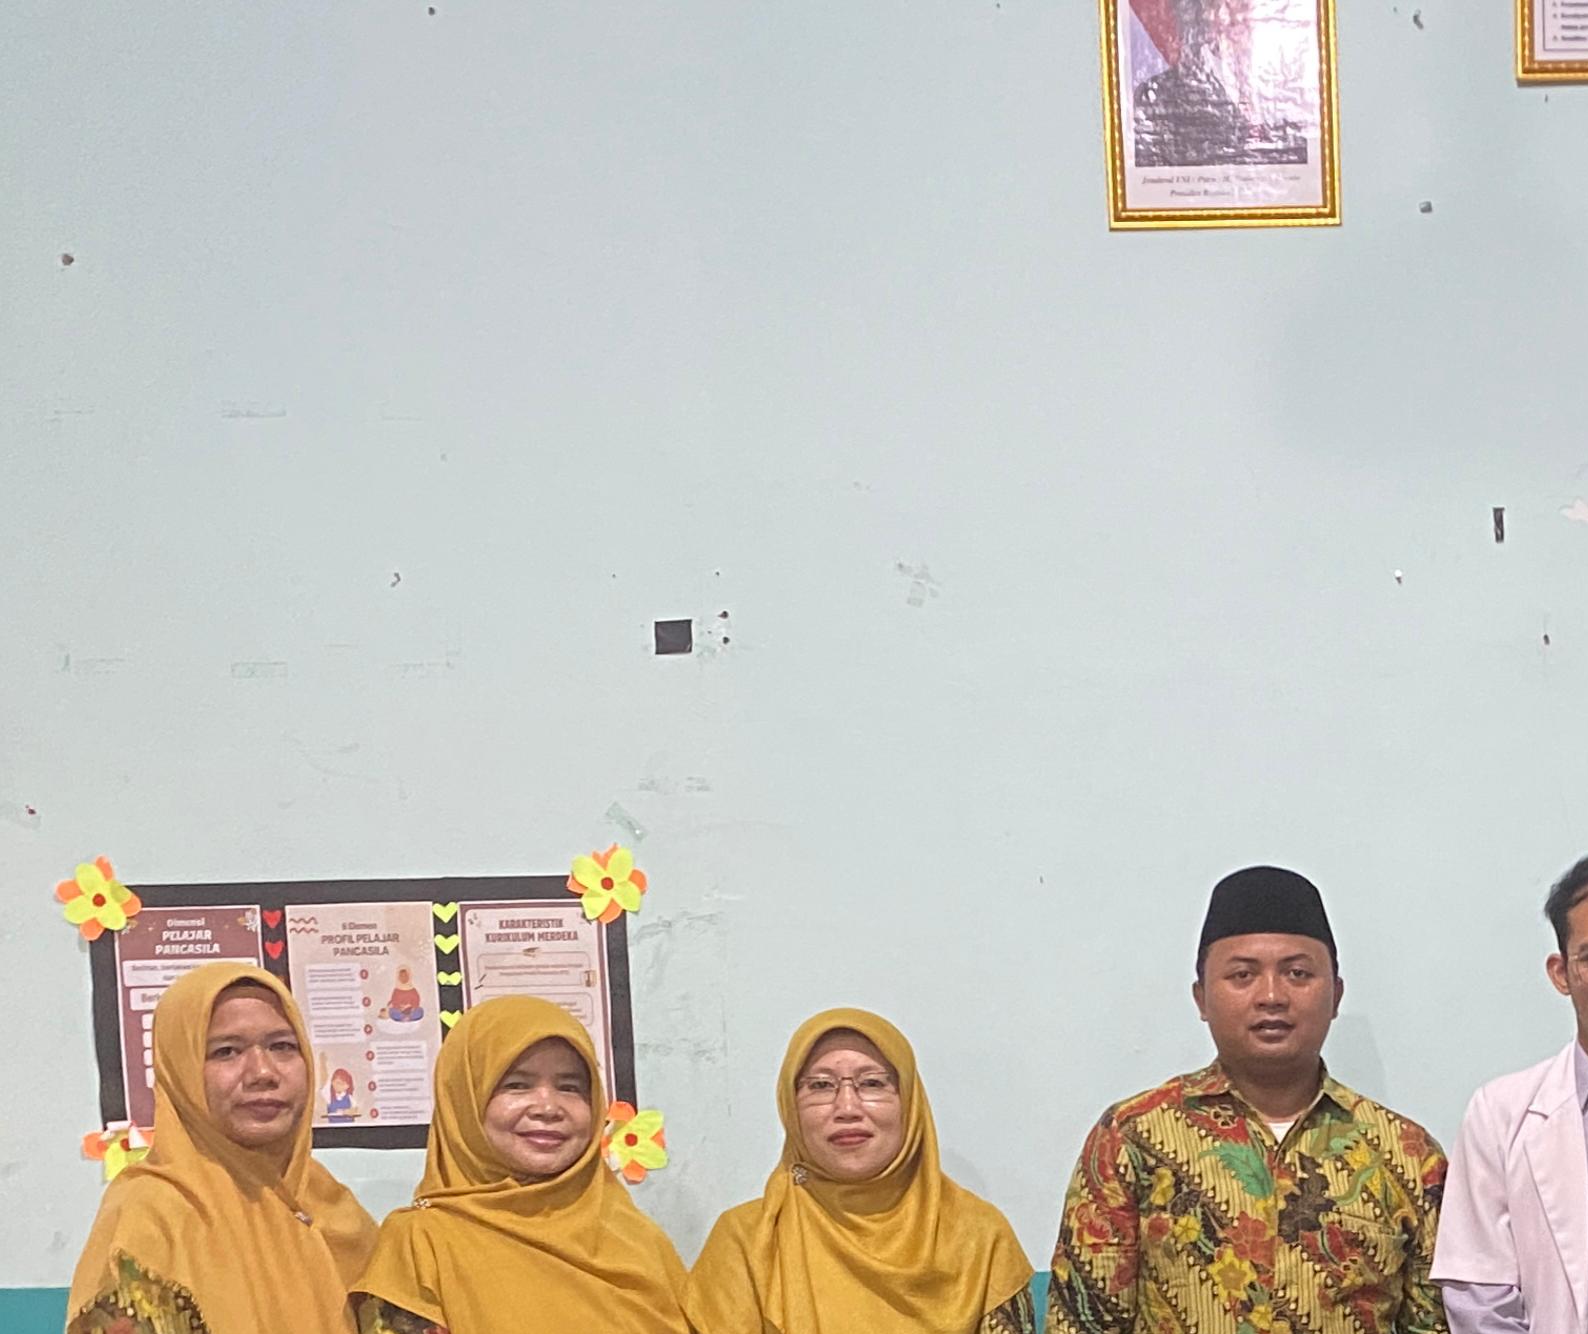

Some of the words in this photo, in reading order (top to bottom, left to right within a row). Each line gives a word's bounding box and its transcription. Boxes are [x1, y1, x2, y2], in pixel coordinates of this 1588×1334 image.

[162, 929, 212, 941] PELAJAR
[321, 934, 355, 944] PROFIL
[356, 933, 400, 943] PELAJAR
[154, 943, 221, 955] PANCASILA
[333, 946, 390, 956] PANCASILA
